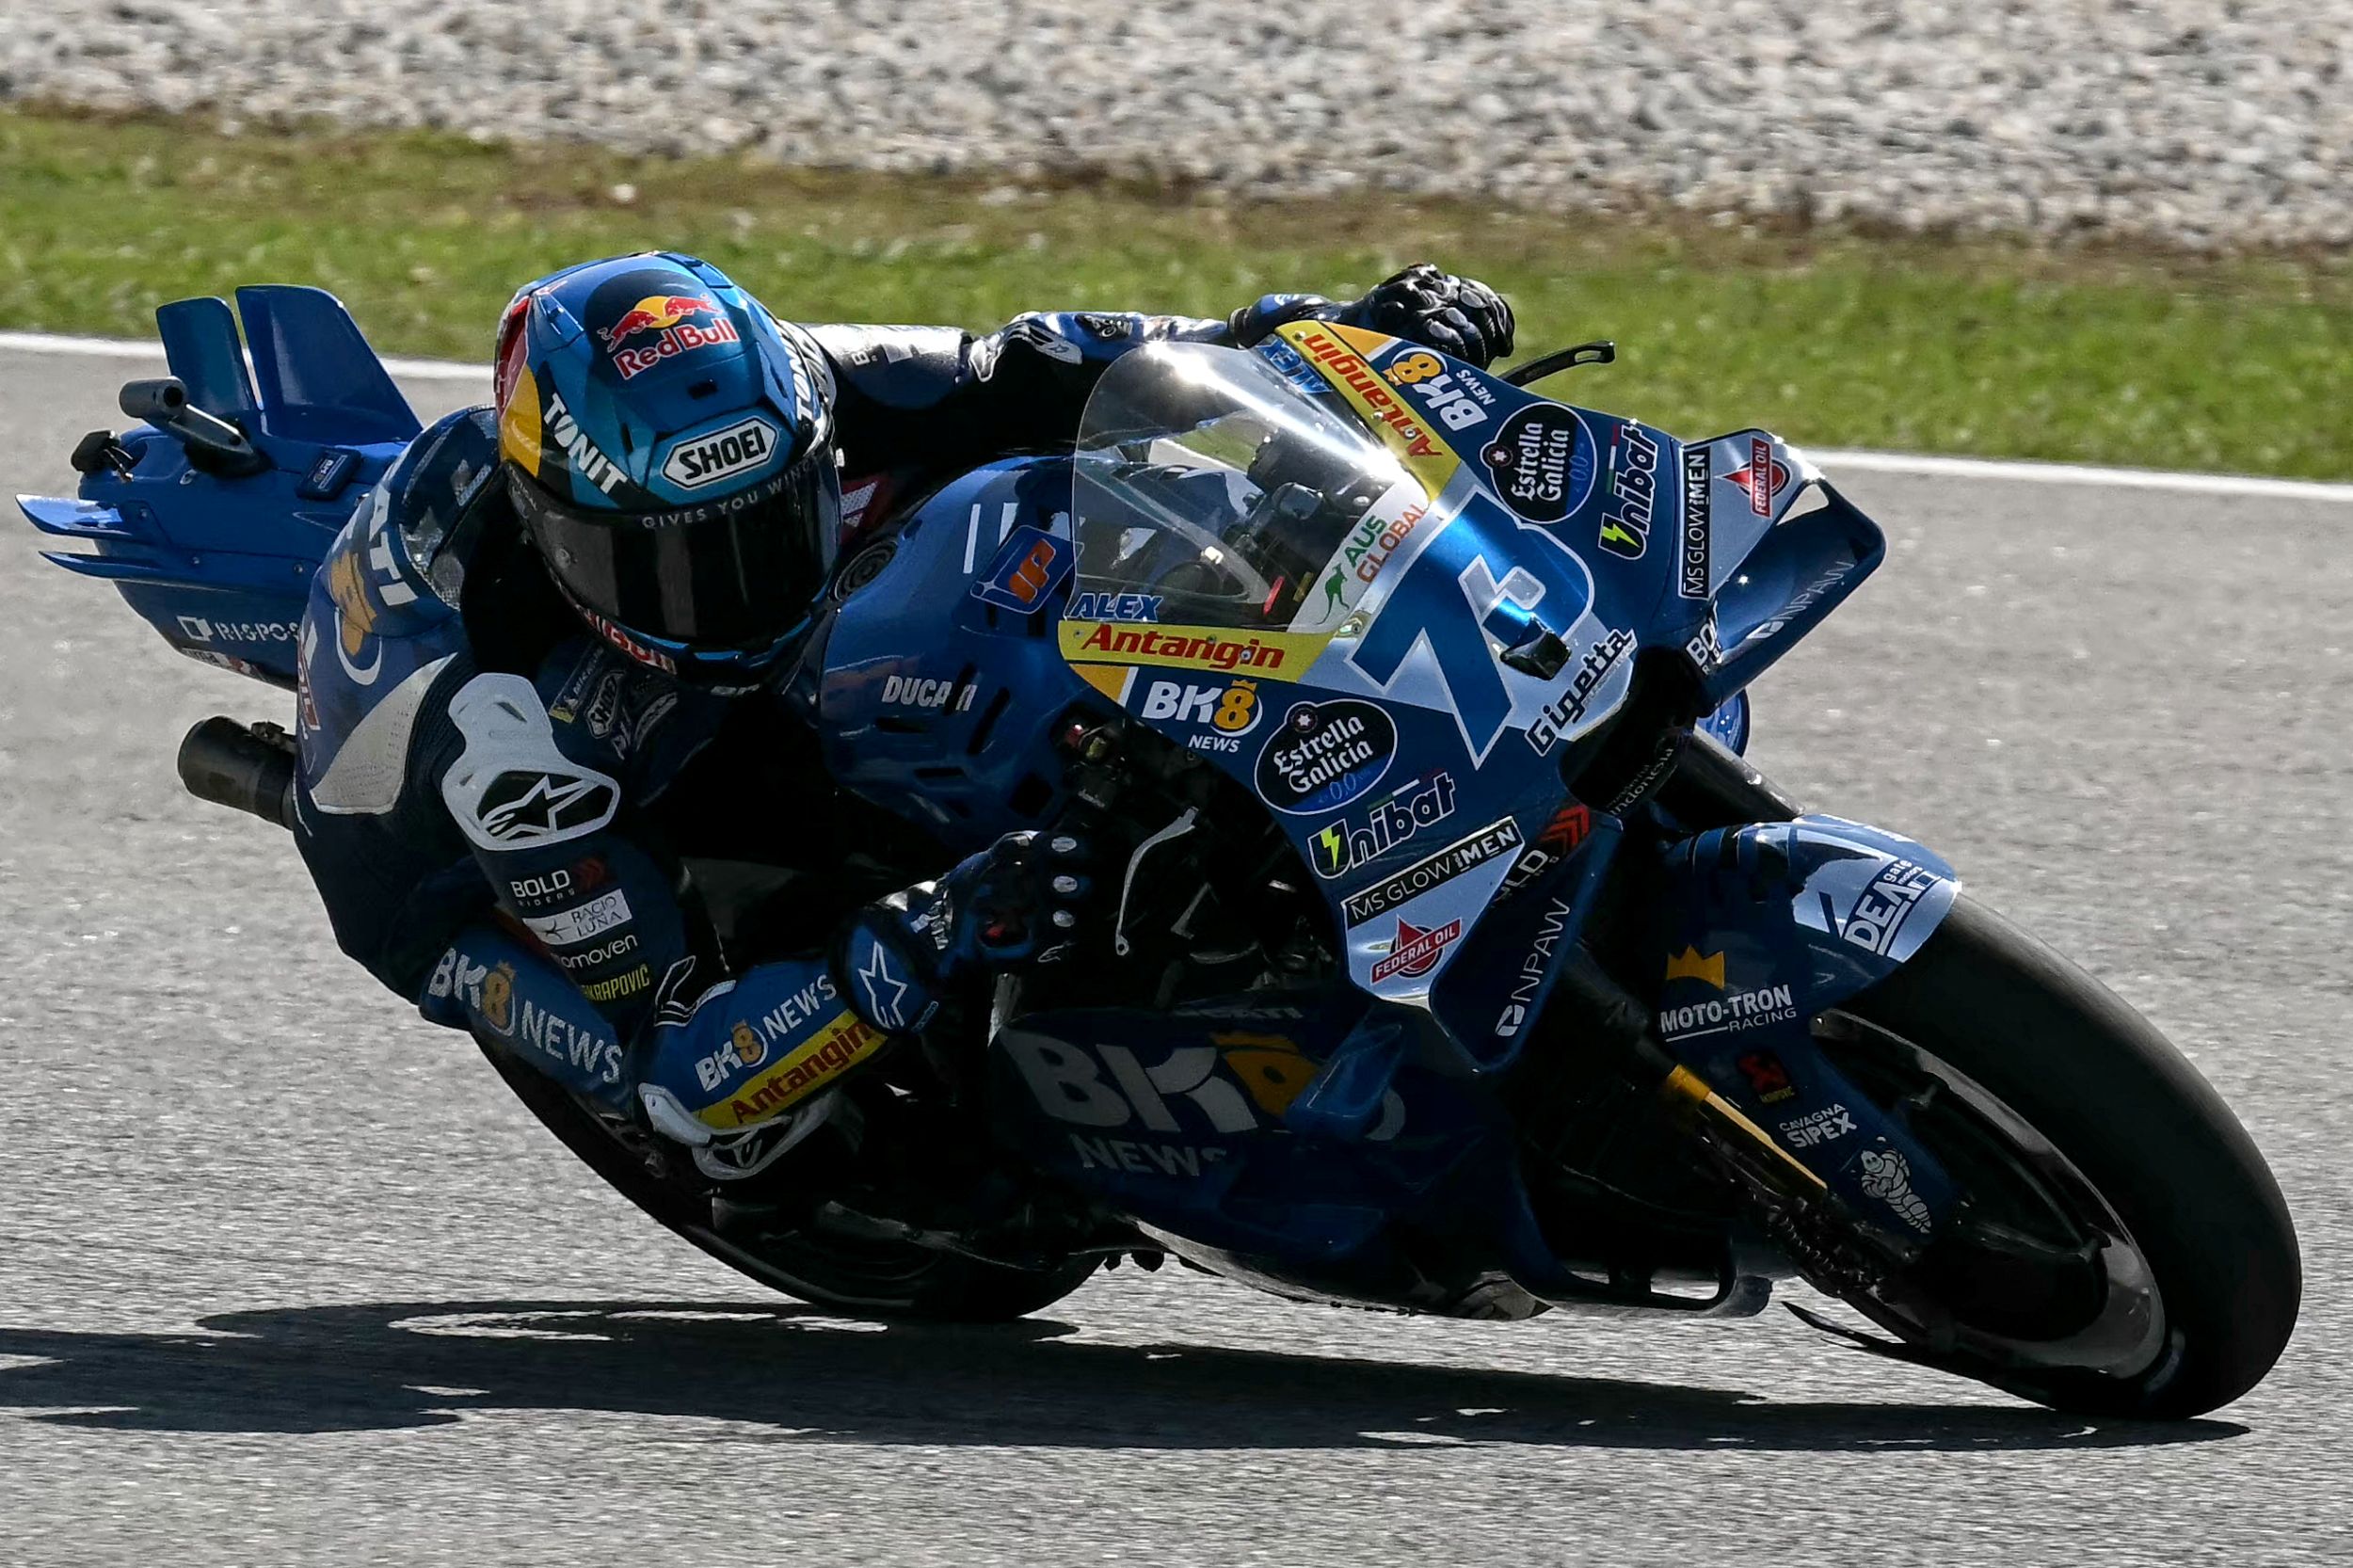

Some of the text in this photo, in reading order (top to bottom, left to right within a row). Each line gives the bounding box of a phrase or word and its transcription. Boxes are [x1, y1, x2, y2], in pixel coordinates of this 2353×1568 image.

[612, 318, 740, 380] Red Bull
[1303, 333, 1443, 457] Antangin
[1384, 347, 1488, 432] BK8
[1456, 369, 1497, 406] NEWS
[543, 392, 629, 495] TONIT
[679, 426, 767, 480] SHOEI
[1511, 422, 1544, 502] Estrella
[1536, 429, 1570, 502] Galicia
[1598, 424, 1658, 560] Unibat
[1754, 445, 1769, 513] FEDERAL OIL
[642, 508, 707, 529] GIVES
[716, 493, 759, 515] YOU
[1687, 505, 1705, 564] GLOW
[1344, 515, 1387, 568] AUS
[1356, 504, 1429, 584] GLOBAL
[1070, 592, 1163, 622] ALEX
[1684, 566, 1705, 594] MS
[1081, 624, 1285, 670] Antangin
[1141, 680, 1263, 738] BK8
[1525, 628, 1638, 757] Gigetta
[1188, 734, 1241, 753] NEWS
[1273, 715, 1364, 776] Estrella
[1289, 740, 1373, 793] Galicia
[1307, 772, 1456, 880] Unibat
[510, 870, 571, 898] BOLD
[1350, 894, 1385, 920] MS
[1386, 856, 1450, 904] GLOW
[1883, 859, 1913, 883] gate
[577, 911, 622, 937] LUNA
[1844, 880, 1922, 952] DEA
[1374, 926, 1457, 978] FEDERAL OIL
[428, 946, 623, 1084] BK8 NEWS
[695, 1017, 769, 1093] BK8
[762, 973, 838, 1042] NEWS
[1659, 984, 1793, 1033] MOTO-TRON
[1728, 1006, 1798, 1032] RACING
[730, 1022, 875, 1124] Antangin
[1779, 1102, 1847, 1132] CAVAGNA
[1787, 1112, 1858, 1149] SIPEX
